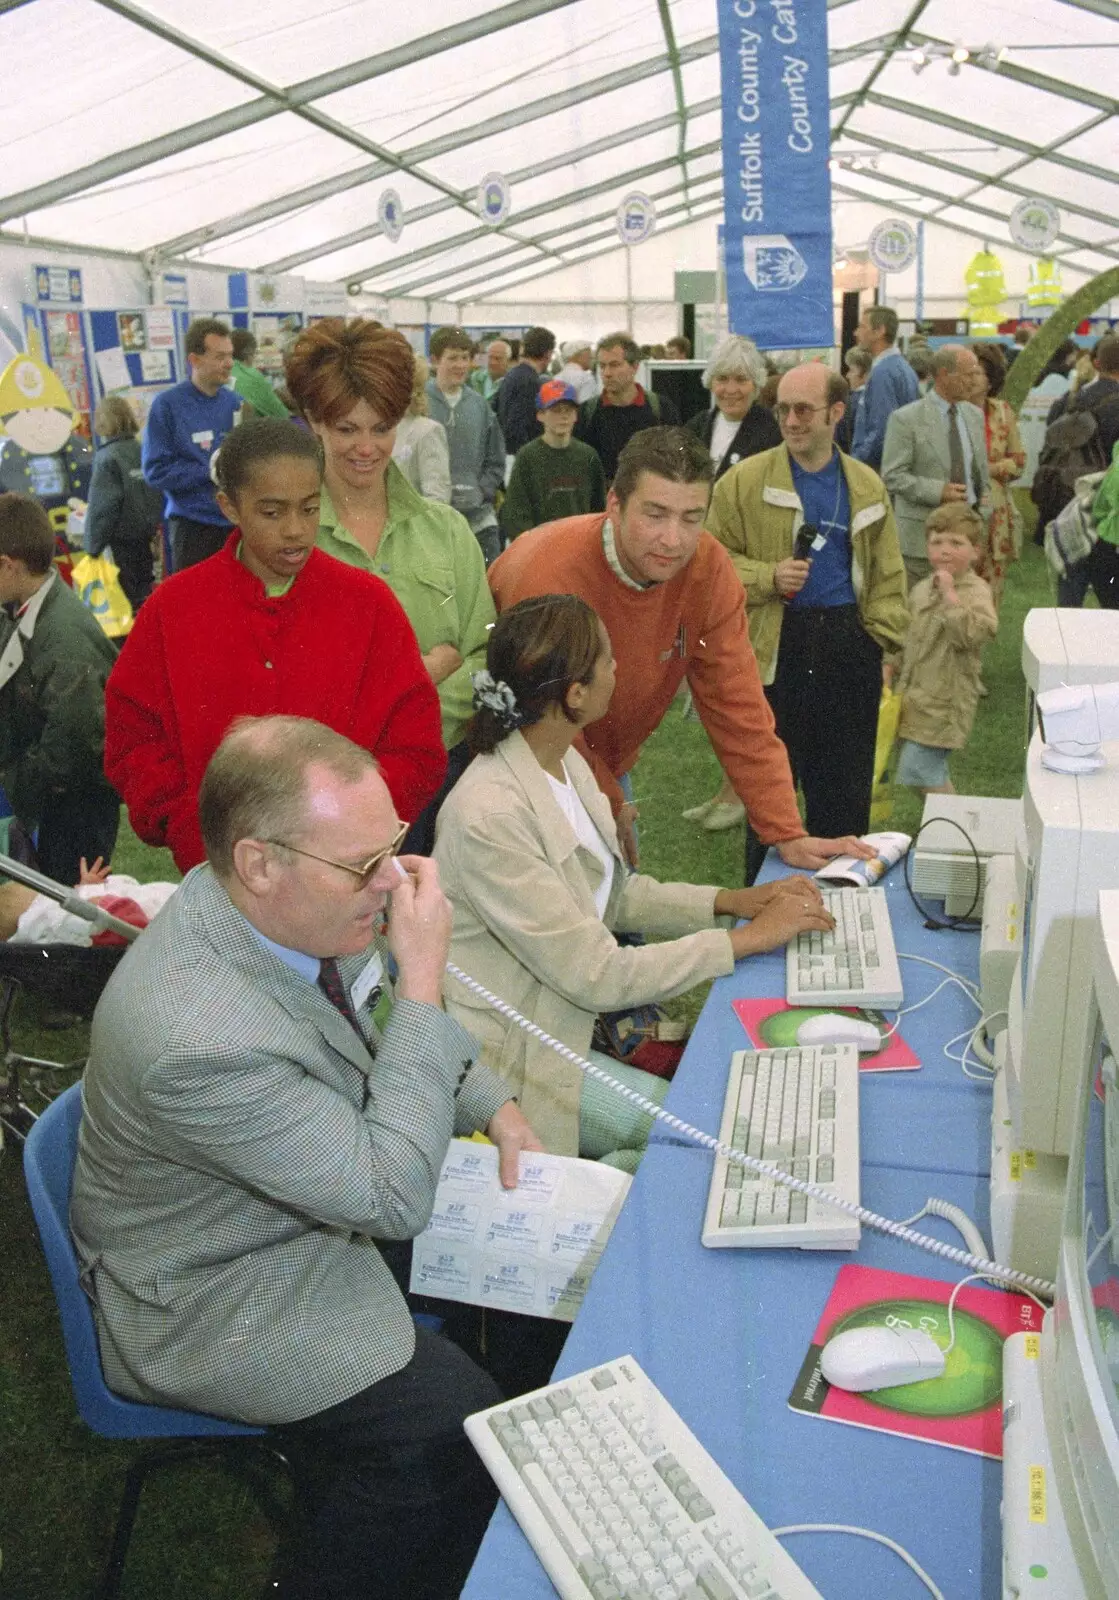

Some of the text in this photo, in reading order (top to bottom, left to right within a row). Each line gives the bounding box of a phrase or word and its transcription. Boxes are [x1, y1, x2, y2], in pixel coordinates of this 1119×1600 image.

[737, 28, 762, 123] County
[781, 55, 813, 153] County
[740, 132, 763, 223] Suffolk
[1020, 1304, 1033, 1319] BT
[804, 1367, 822, 1402] Internet
